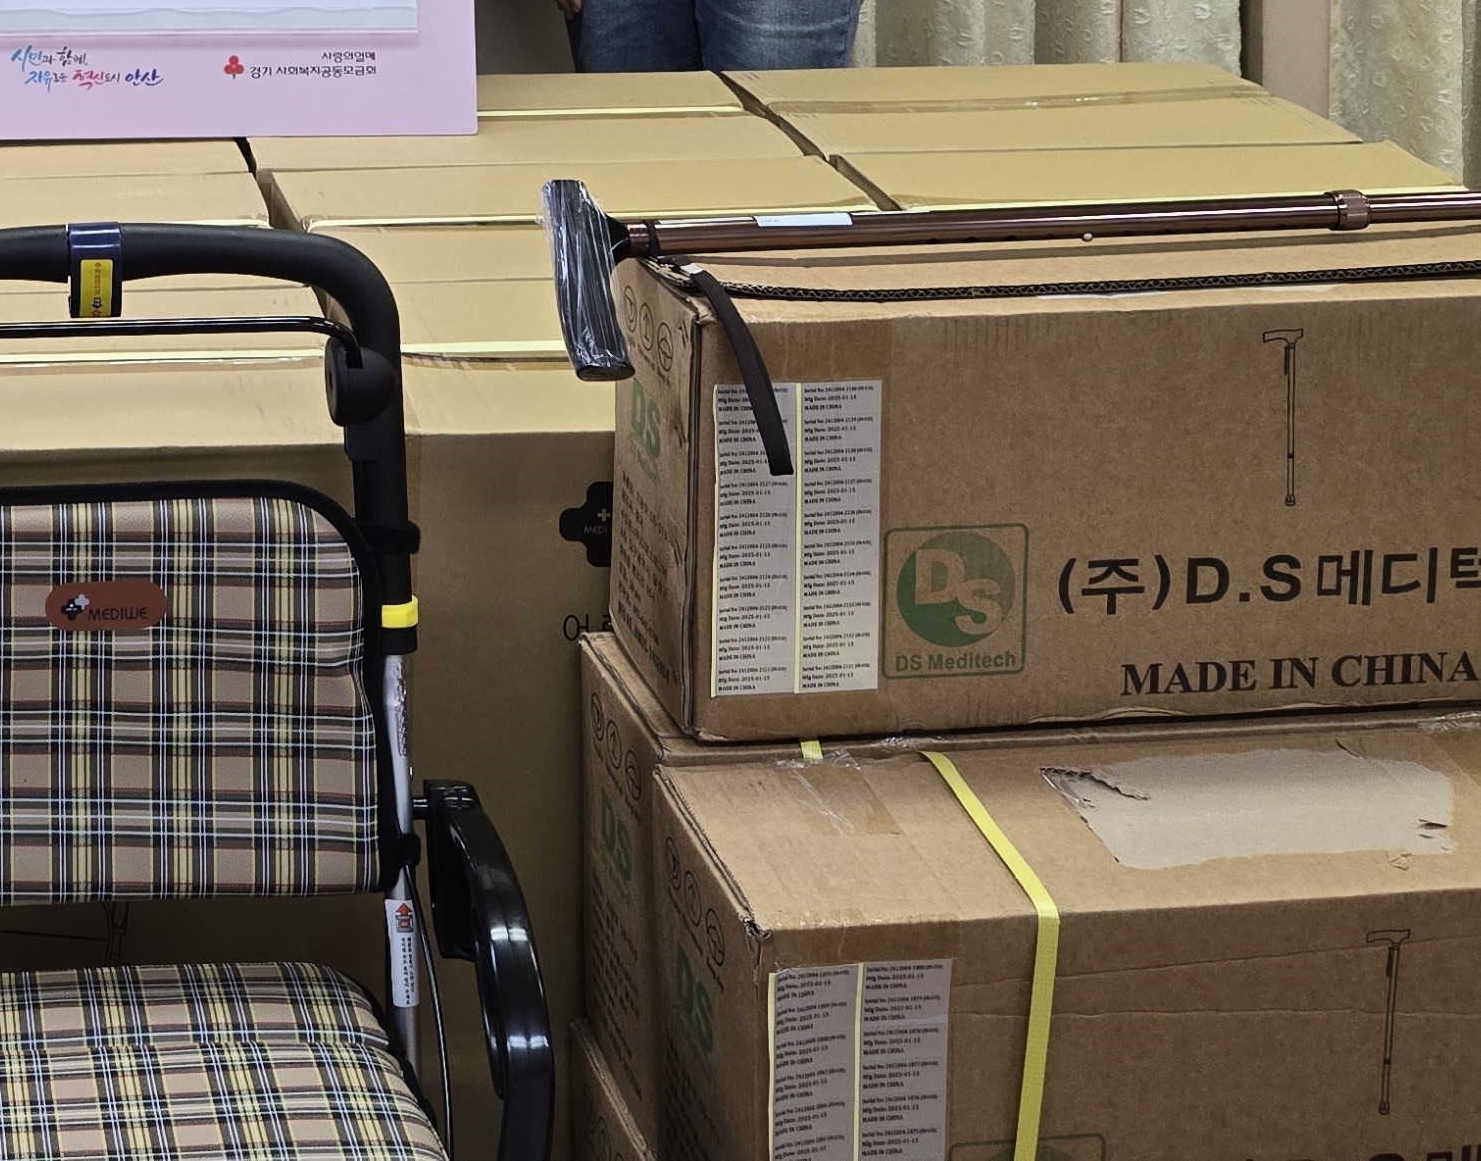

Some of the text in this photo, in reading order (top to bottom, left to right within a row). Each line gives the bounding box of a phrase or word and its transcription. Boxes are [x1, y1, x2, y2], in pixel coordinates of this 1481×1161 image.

[10, 45, 56, 72] 시민과
[125, 68, 164, 86] 안산
[249, 66, 272, 79] 경기
[895, 649, 1017, 672] DS Meditech
[1120, 650, 1480, 697] MADE IN CHINA
